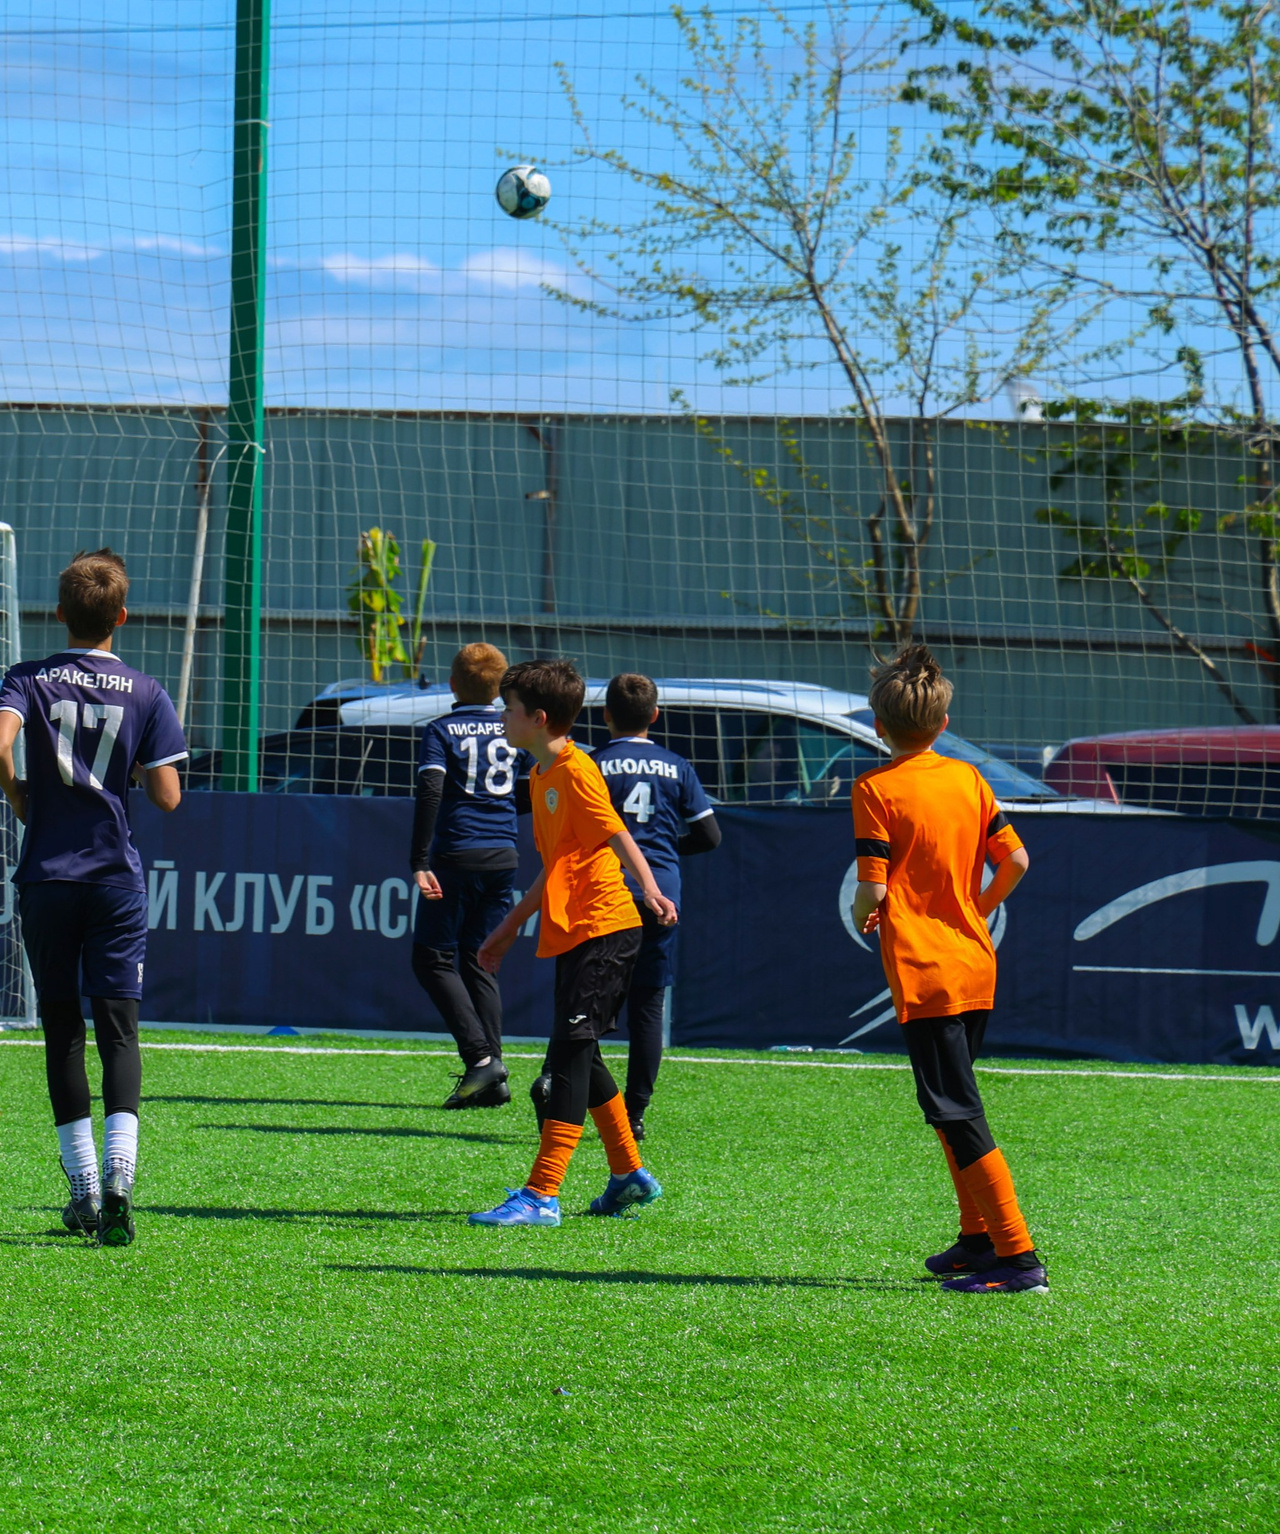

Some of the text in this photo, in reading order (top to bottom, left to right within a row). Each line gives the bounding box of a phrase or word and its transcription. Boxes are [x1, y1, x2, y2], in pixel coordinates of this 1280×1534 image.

[35, 667, 133, 693] АРАКЕЛЯН
[50, 700, 124, 790] 17
[447, 722, 505, 736] ПИСАРЕ
[460, 736, 518, 795] 18
[600, 757, 678, 779] КЮЛЯН
[623, 781, 655, 823] 4
[193, 871, 335, 936] КЛУБ
